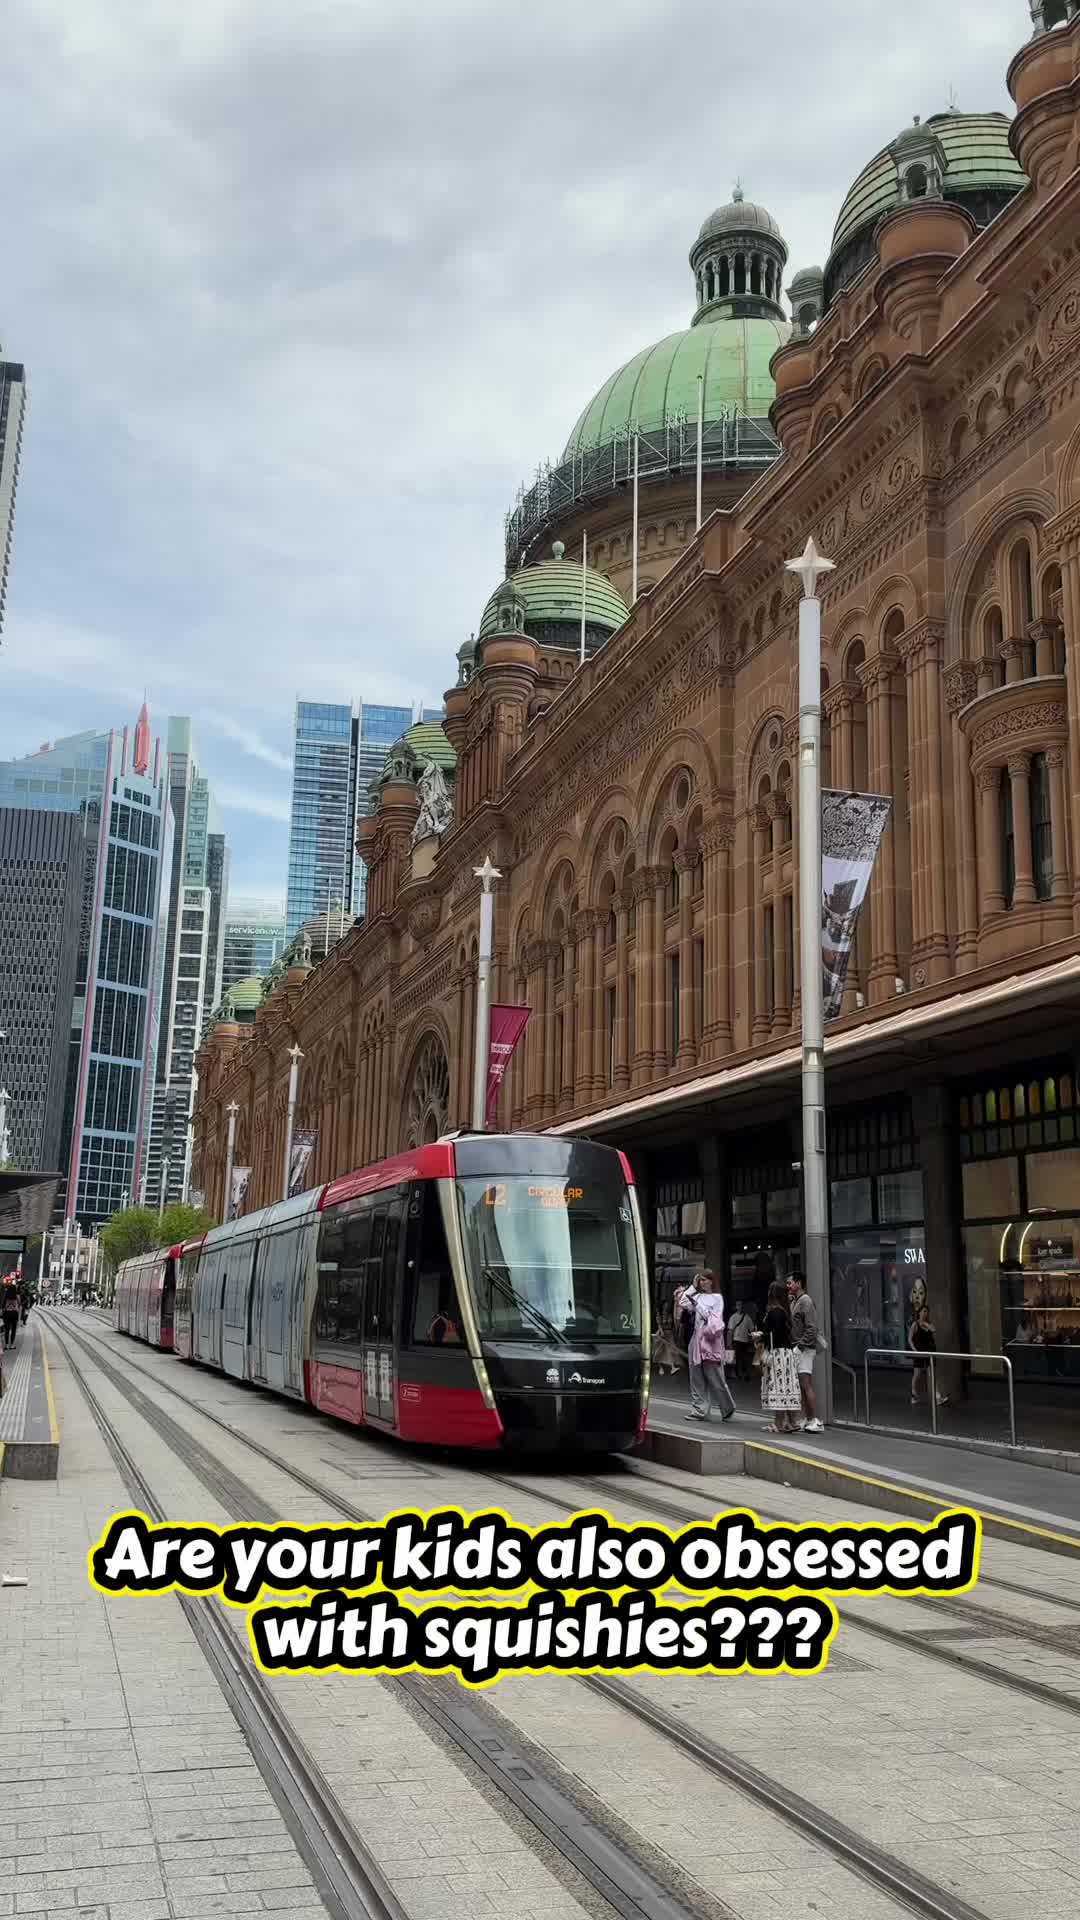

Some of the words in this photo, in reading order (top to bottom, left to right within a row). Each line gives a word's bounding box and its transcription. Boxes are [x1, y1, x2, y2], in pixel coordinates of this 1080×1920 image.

[485, 1184, 506, 1206] L2
[528, 1187, 584, 1199] CIRCULAR
[620, 1313, 636, 1329] 24
